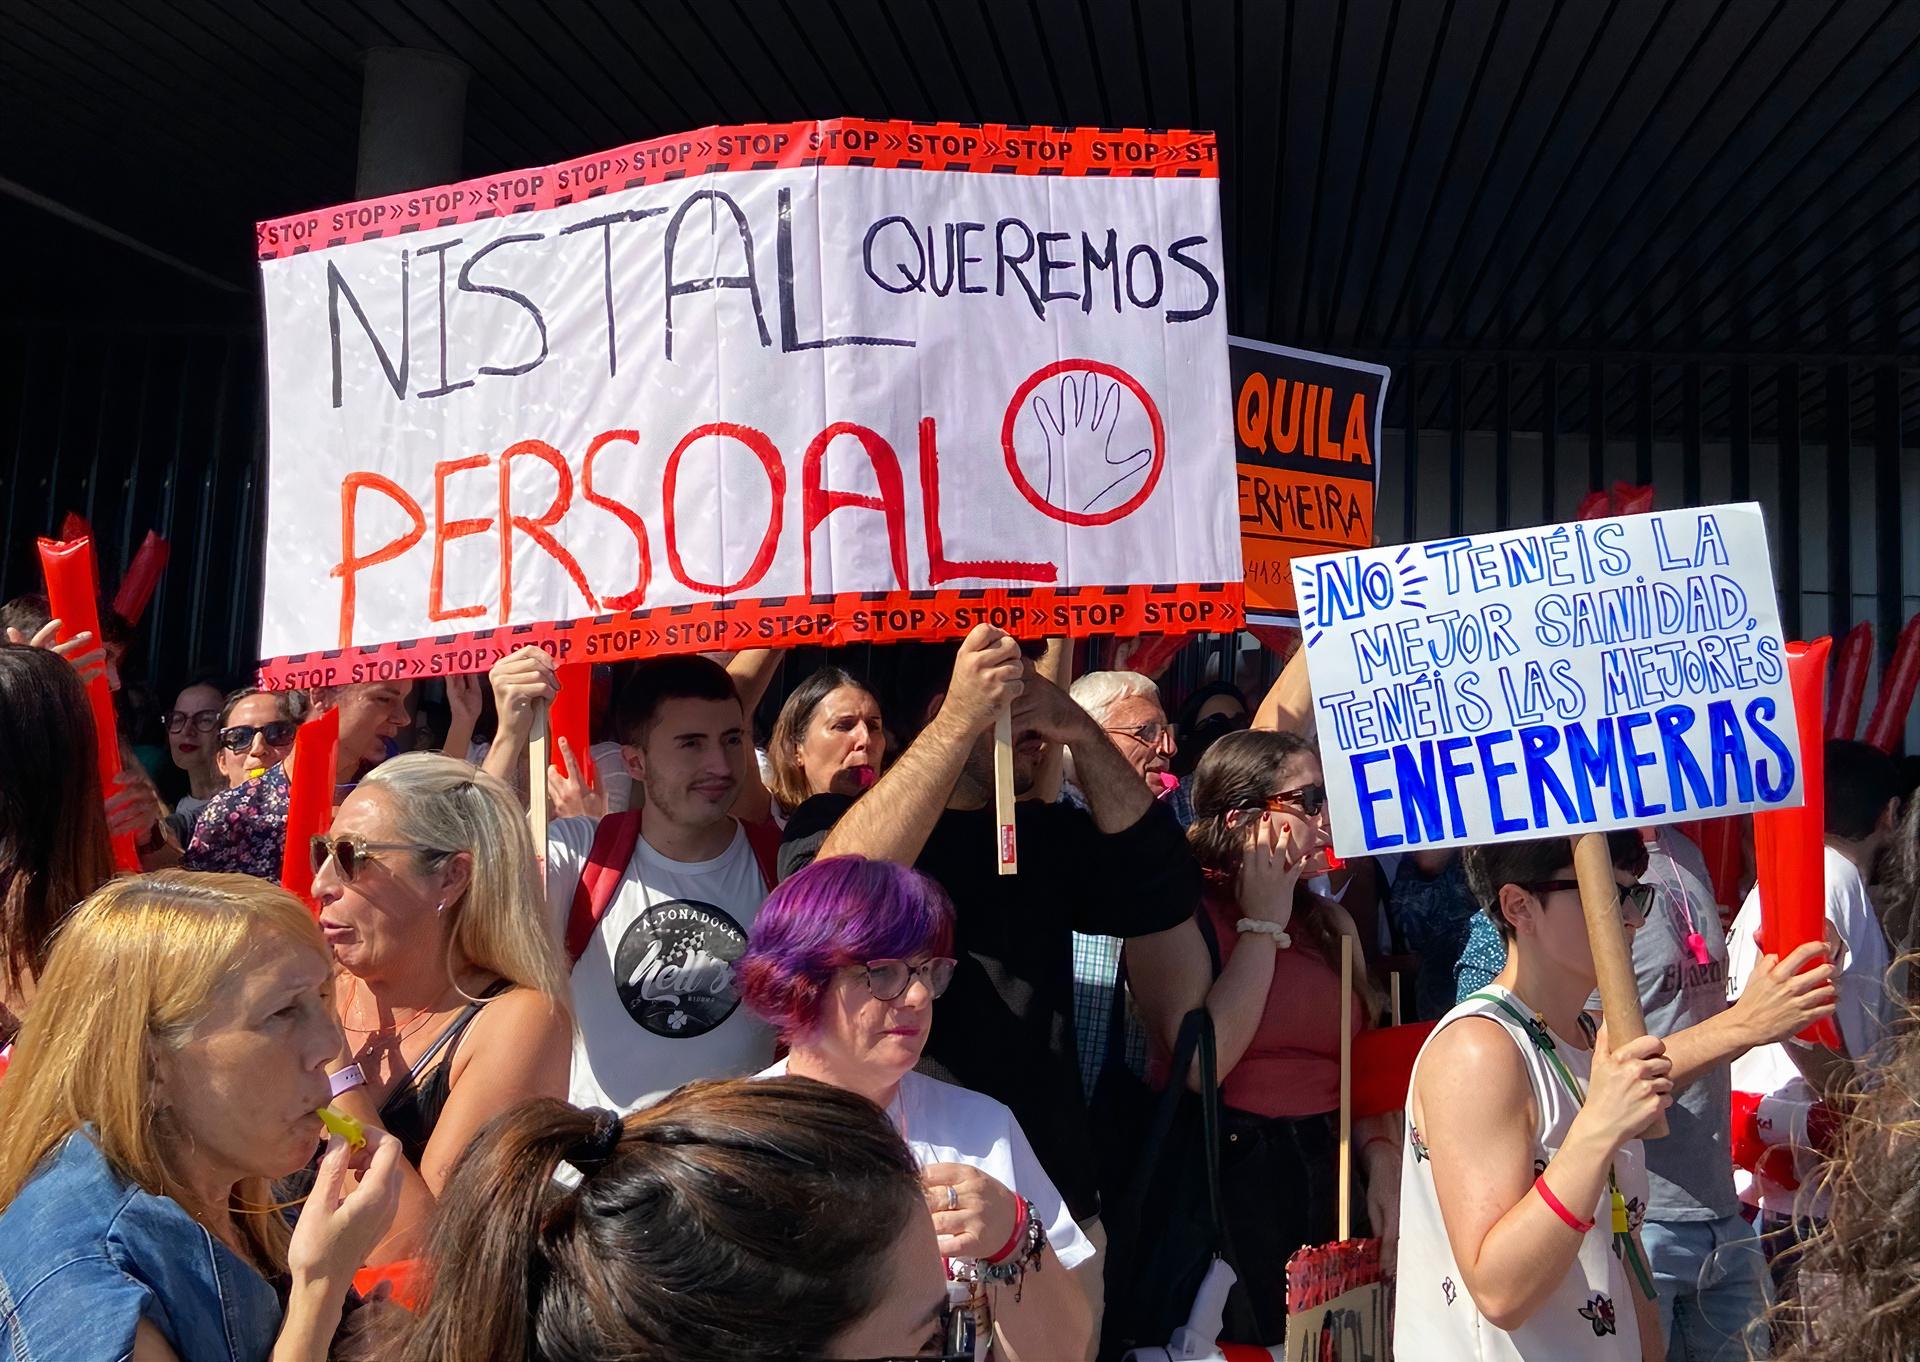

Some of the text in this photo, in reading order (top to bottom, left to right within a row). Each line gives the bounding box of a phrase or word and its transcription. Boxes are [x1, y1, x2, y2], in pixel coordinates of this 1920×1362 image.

[268, 219, 318, 245] STOP
[333, 205, 386, 231] STOP
[407, 191, 465, 218] STOP
[487, 176, 545, 202] STOP
[558, 159, 611, 189] STOP
[633, 142, 692, 170] STOP
[717, 134, 790, 156] STOP
[809, 129, 880, 150] STOP
[907, 134, 977, 157] STOP
[1005, 138, 1072, 161] STOP
[1092, 141, 1159, 161] STOP
[328, 187, 1220, 408] NISTAL QUEREMOS
[1237, 372, 1373, 465] QUILA
[330, 417, 1058, 649] PERSOAL
[1314, 555, 1395, 627] NO
[1651, 514, 1729, 572] LA
[285, 600, 1215, 690] STOP STOP STOP OP STOP STOP STOP STOP STOP STOP STOP
[1351, 603, 1520, 685] MEJOR
[1498, 659, 1586, 726] LAS
[1600, 635, 1783, 715] MEJORES
[1349, 696, 1795, 851] ENFERMERAS
[642, 909, 738, 940] ATONADOCK
